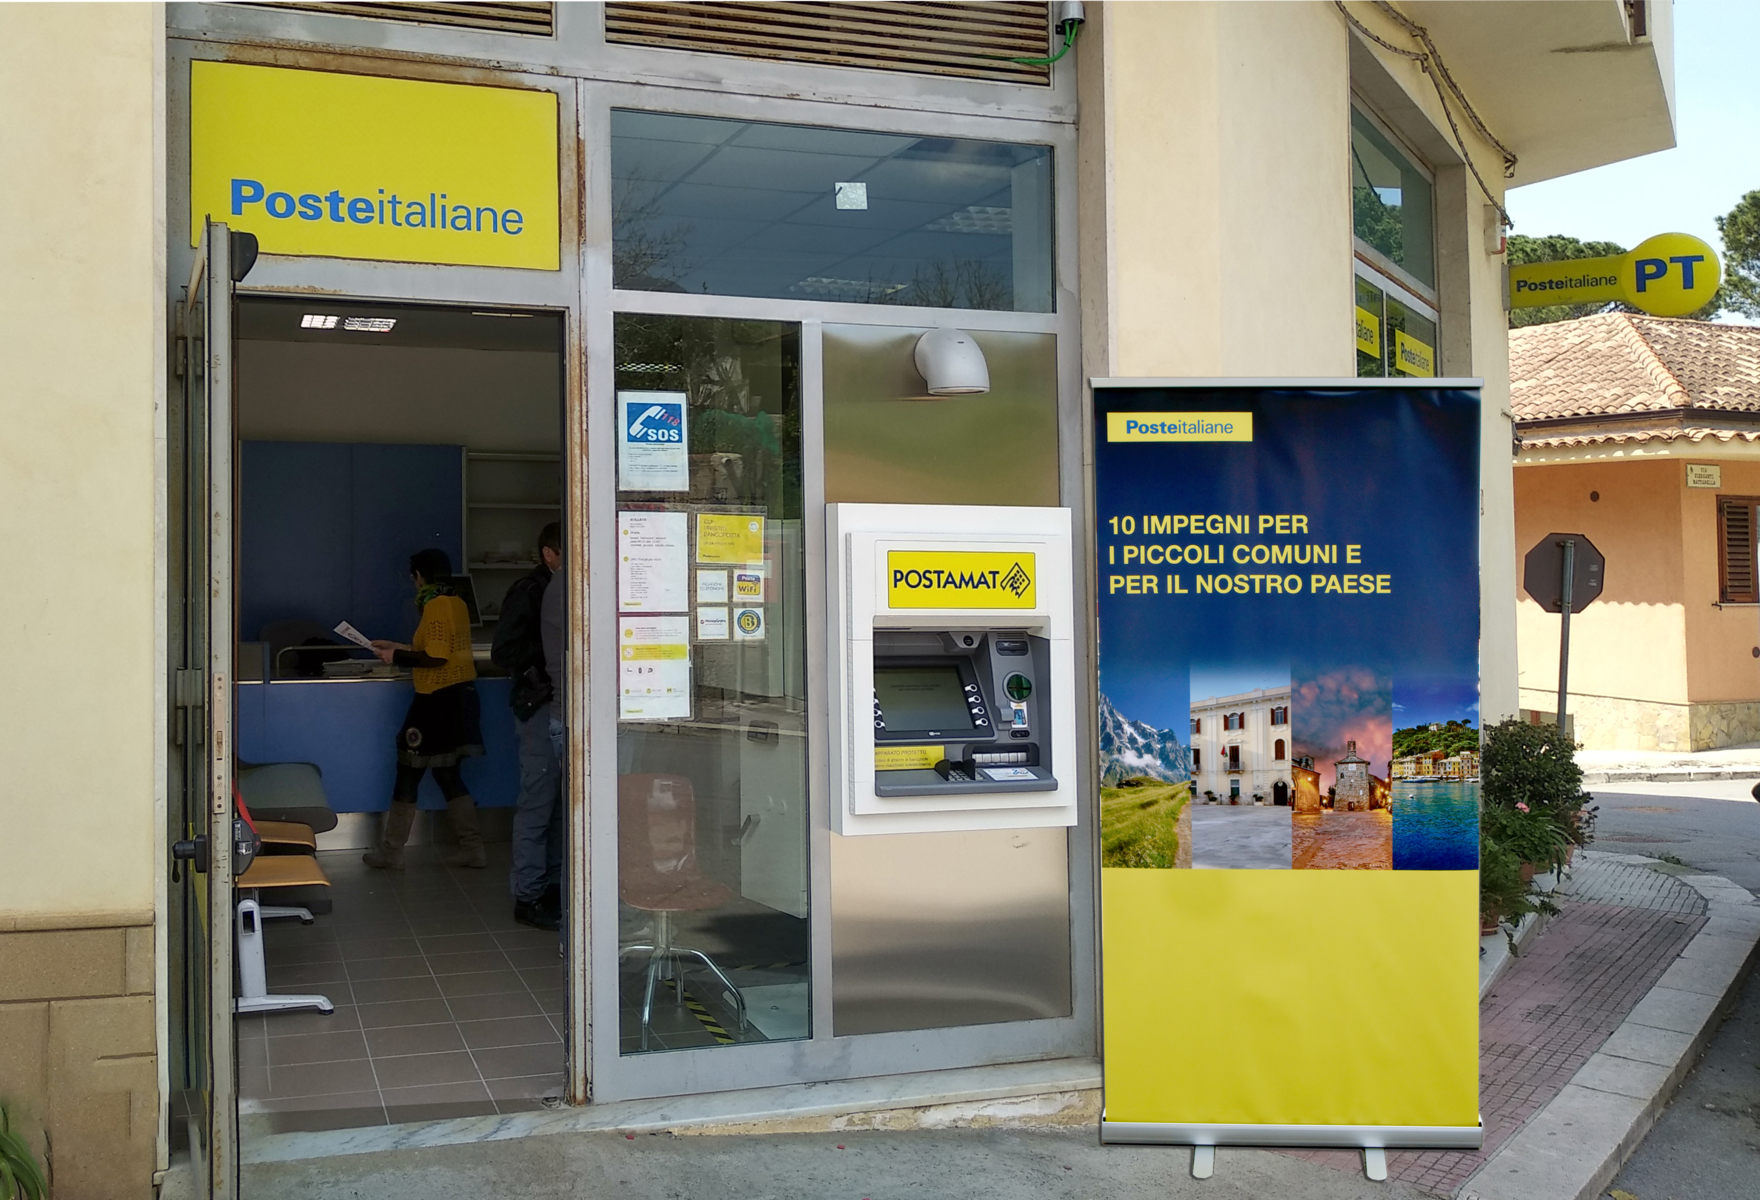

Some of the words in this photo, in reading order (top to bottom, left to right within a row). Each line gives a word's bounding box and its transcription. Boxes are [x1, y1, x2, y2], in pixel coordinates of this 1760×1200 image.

[230, 178, 524, 235] Posteitaliane
[1516, 274, 1617, 292] Posteitaliane
[1635, 255, 1705, 293] PT
[1401, 341, 1430, 372] Posteitaliane
[661, 413, 680, 426] 118
[1126, 419, 1233, 435] Posteitaliane
[647, 429, 679, 441] SOS
[1109, 515, 1136, 535] 10
[1143, 514, 1250, 534] IMPEGNI
[1258, 514, 1309, 534] PER
[1109, 545, 1115, 565] I
[1123, 544, 1225, 564] PICCOLI
[1232, 544, 1338, 564] COMUNI
[1346, 544, 1362, 564] E
[893, 569, 999, 589] POSTAMAT
[1109, 574, 1159, 594] PER
[1167, 574, 1189, 594] IL
[1196, 574, 1303, 594] NOSTRO
[1311, 574, 1391, 594] PAESE
